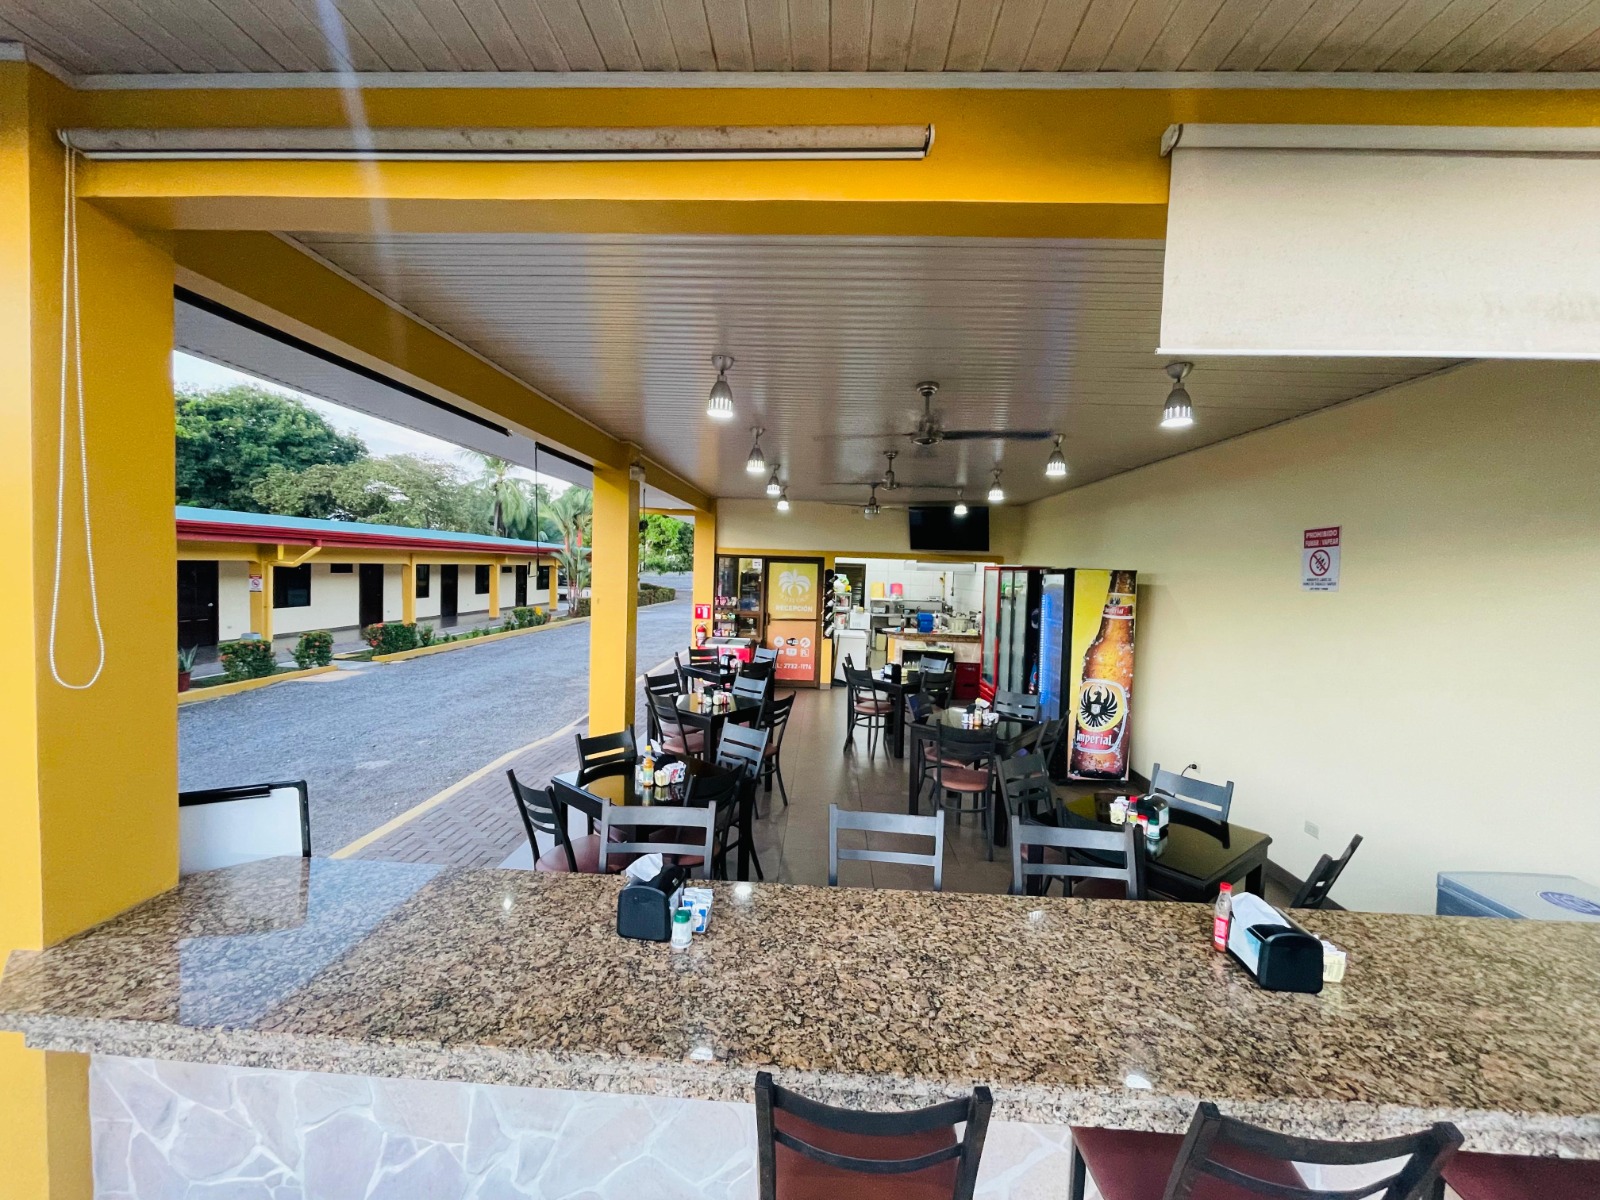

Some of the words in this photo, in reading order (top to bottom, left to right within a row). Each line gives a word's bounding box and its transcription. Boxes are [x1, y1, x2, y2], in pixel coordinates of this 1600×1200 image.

[1306, 530, 1338, 539] PROHIBIDO
[775, 604, 813, 612] RECEPCIÓN
[1076, 729, 1112, 746] Imperial
